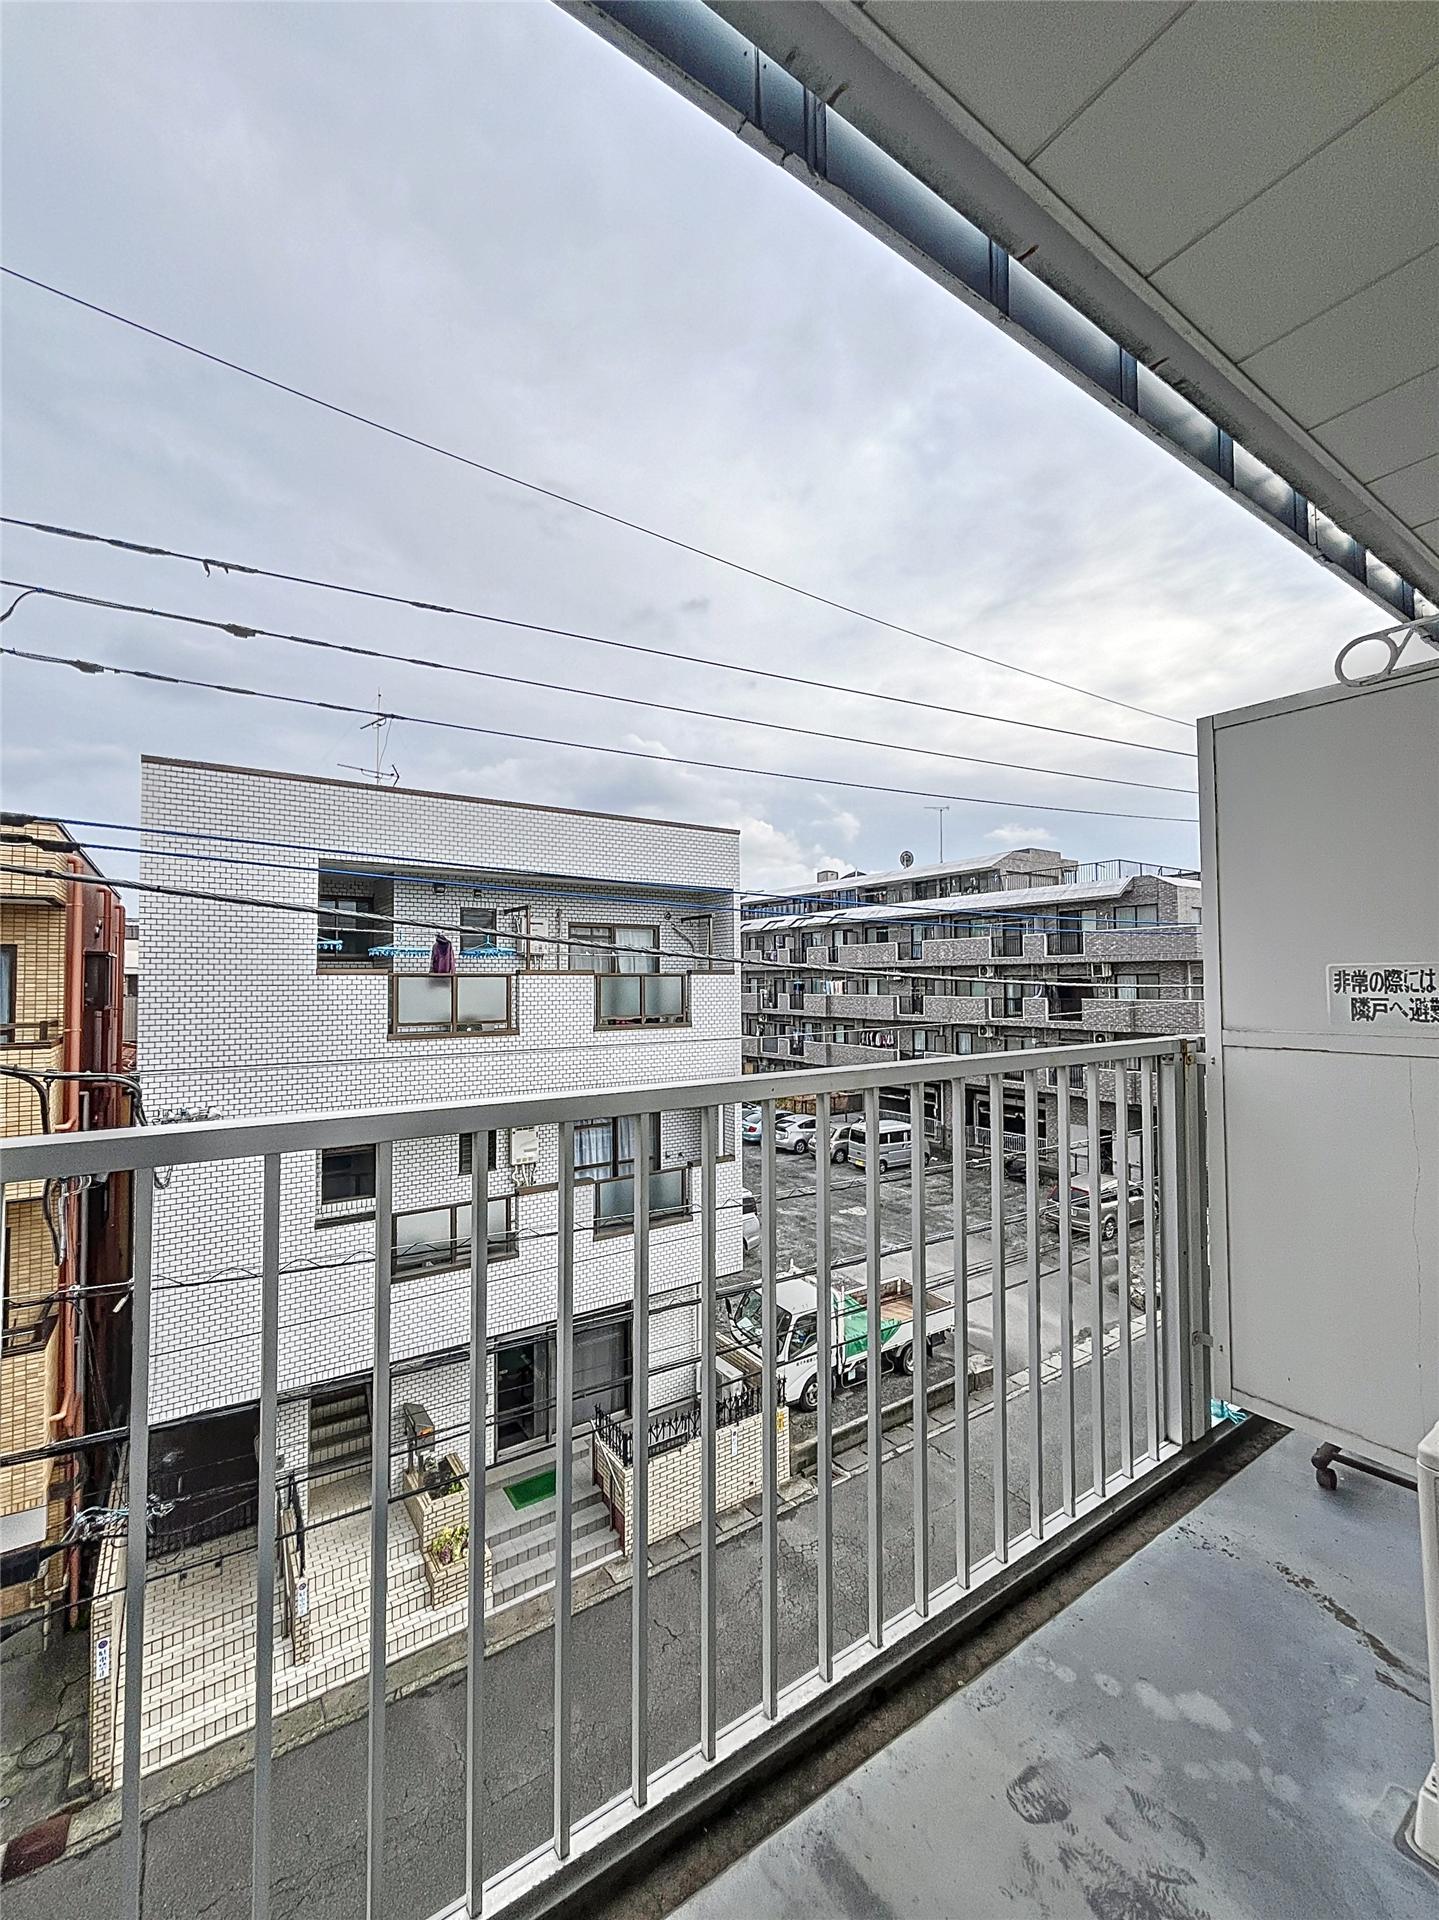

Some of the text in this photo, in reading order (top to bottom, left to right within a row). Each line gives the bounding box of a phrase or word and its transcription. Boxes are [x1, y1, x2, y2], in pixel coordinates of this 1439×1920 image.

[1334, 968, 1437, 994] 非常の際には
